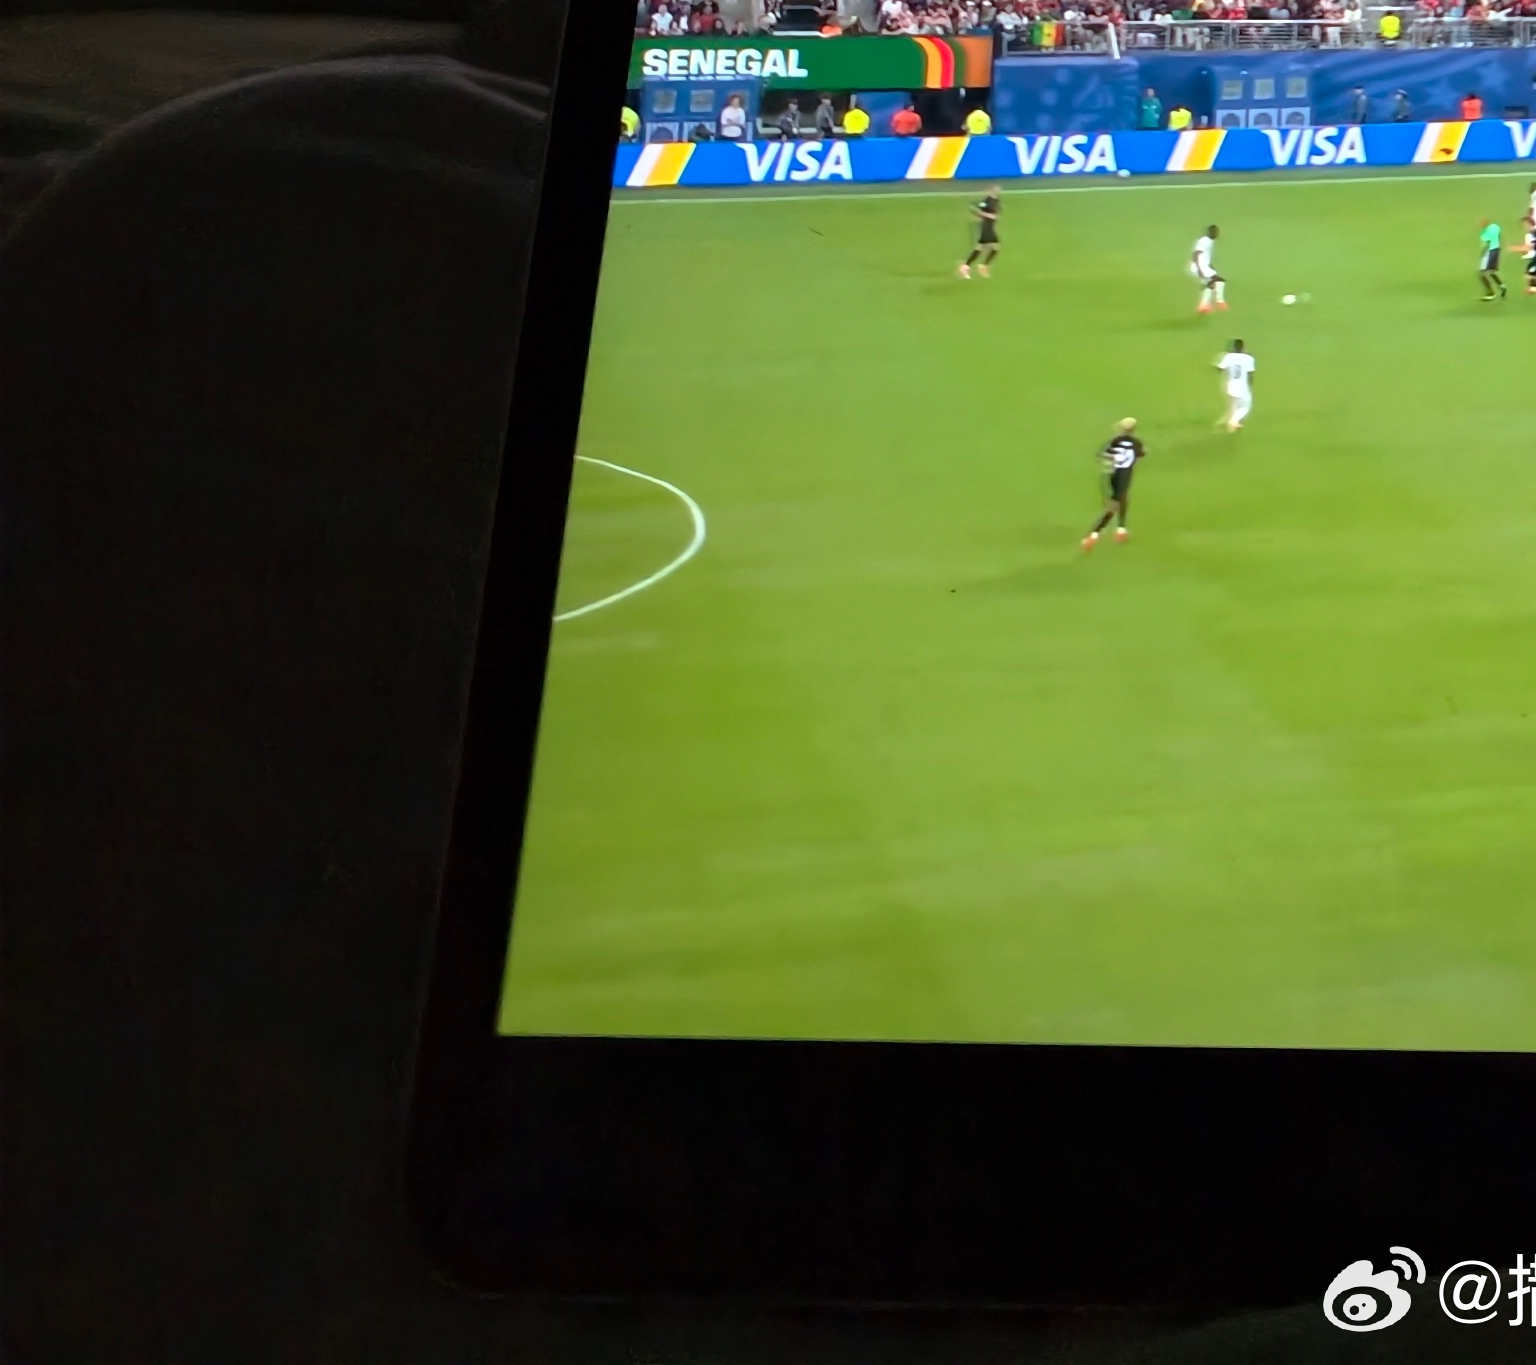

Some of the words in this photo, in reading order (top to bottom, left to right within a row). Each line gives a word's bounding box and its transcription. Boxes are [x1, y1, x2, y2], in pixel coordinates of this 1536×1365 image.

[643, 48, 808, 79] SENEGAL
[737, 141, 852, 182] VISA
[1006, 133, 1118, 176] VISA
[1262, 126, 1365, 166] VISA
